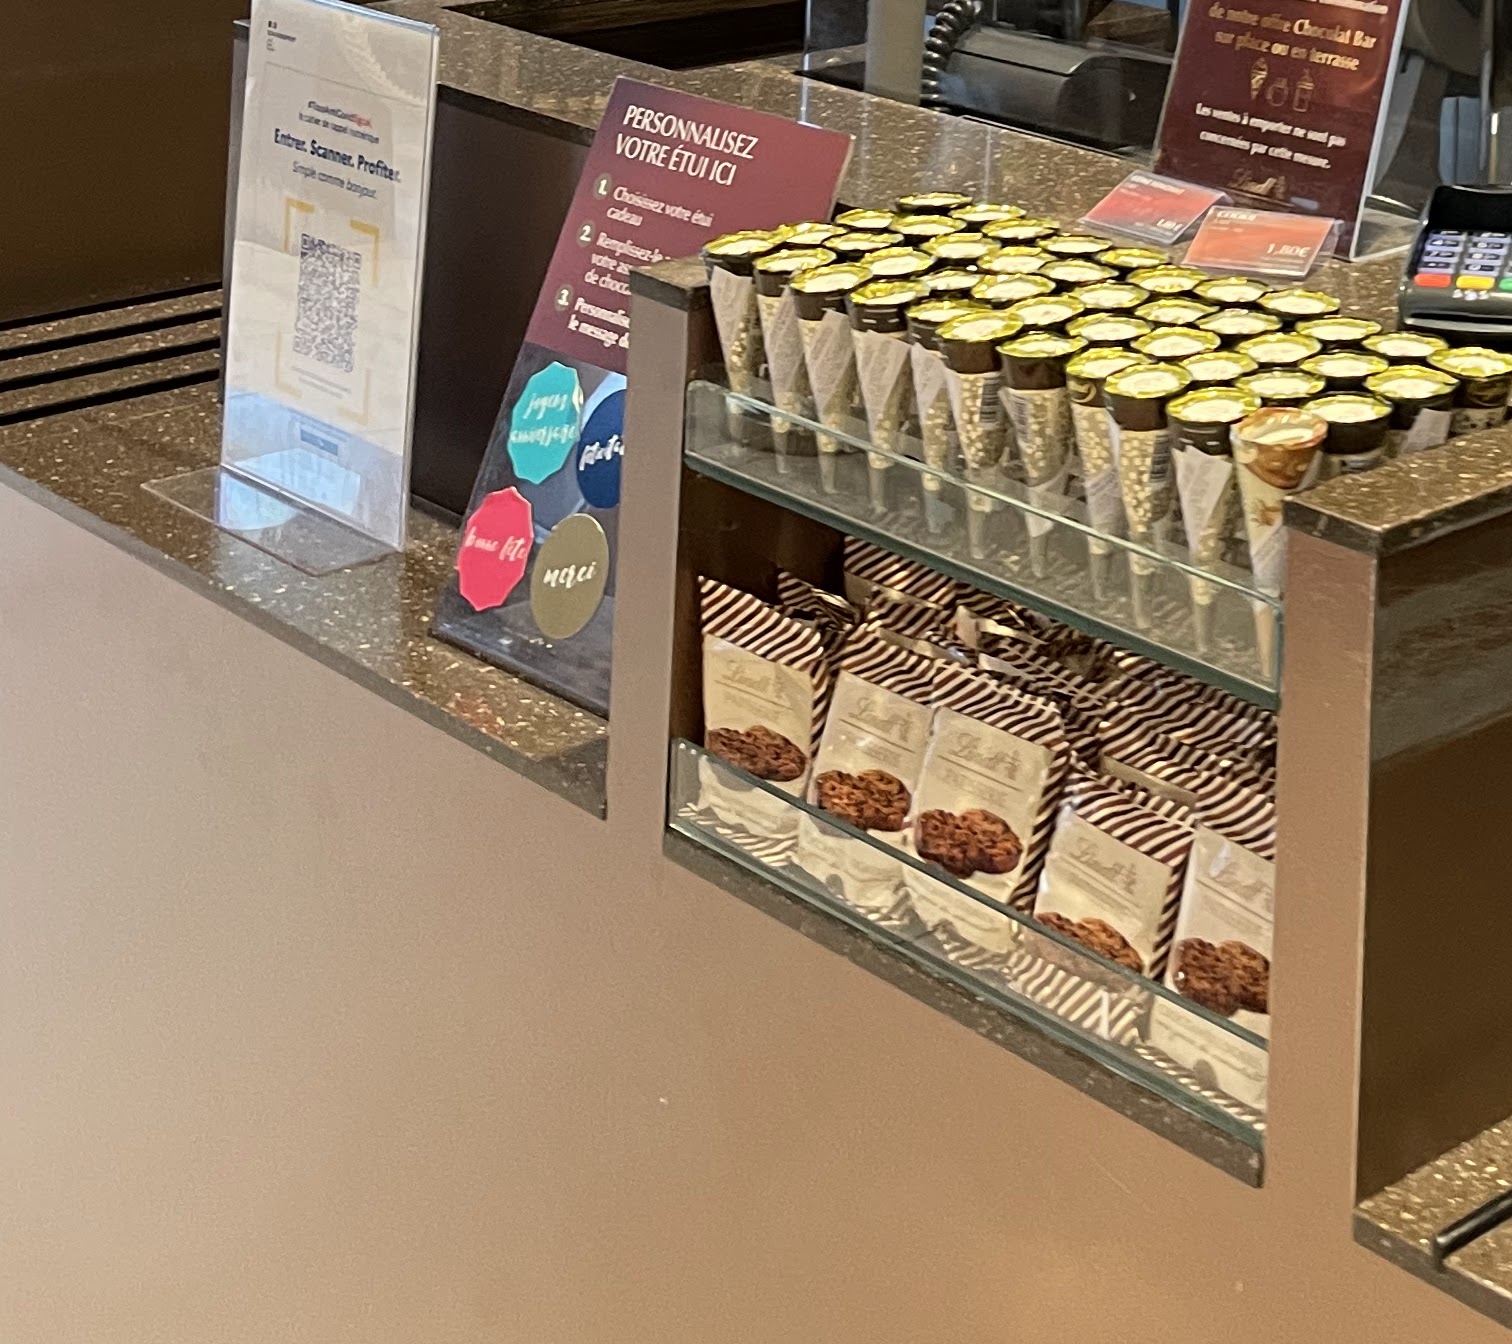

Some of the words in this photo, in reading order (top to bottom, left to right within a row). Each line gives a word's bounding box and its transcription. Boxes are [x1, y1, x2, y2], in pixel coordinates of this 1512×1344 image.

[1292, 19, 1351, 44] Chocolat
[1352, 30, 1377, 49] Bar
[1309, 47, 1360, 71] terrasse
[623, 105, 759, 160] PERSONNALISEZ
[274, 128, 307, 153] Entrer.
[310, 139, 355, 168] Scanner.
[357, 154, 401, 184] Profiter.
[615, 133, 666, 169] VOTRE
[668, 144, 708, 179] ÉTUI
[709, 159, 737, 186] ICI
[606, 206, 644, 227] cadeau
[613, 185, 665, 214] Choisissez
[664, 204, 692, 223] votre
[691, 209, 715, 228] étui
[591, 253, 618, 271] votre
[596, 232, 663, 263] Remplissez-le
[584, 269, 599, 286] de
[568, 315, 578, 331] le
[578, 322, 619, 348] message
[543, 561, 596, 588] merci
